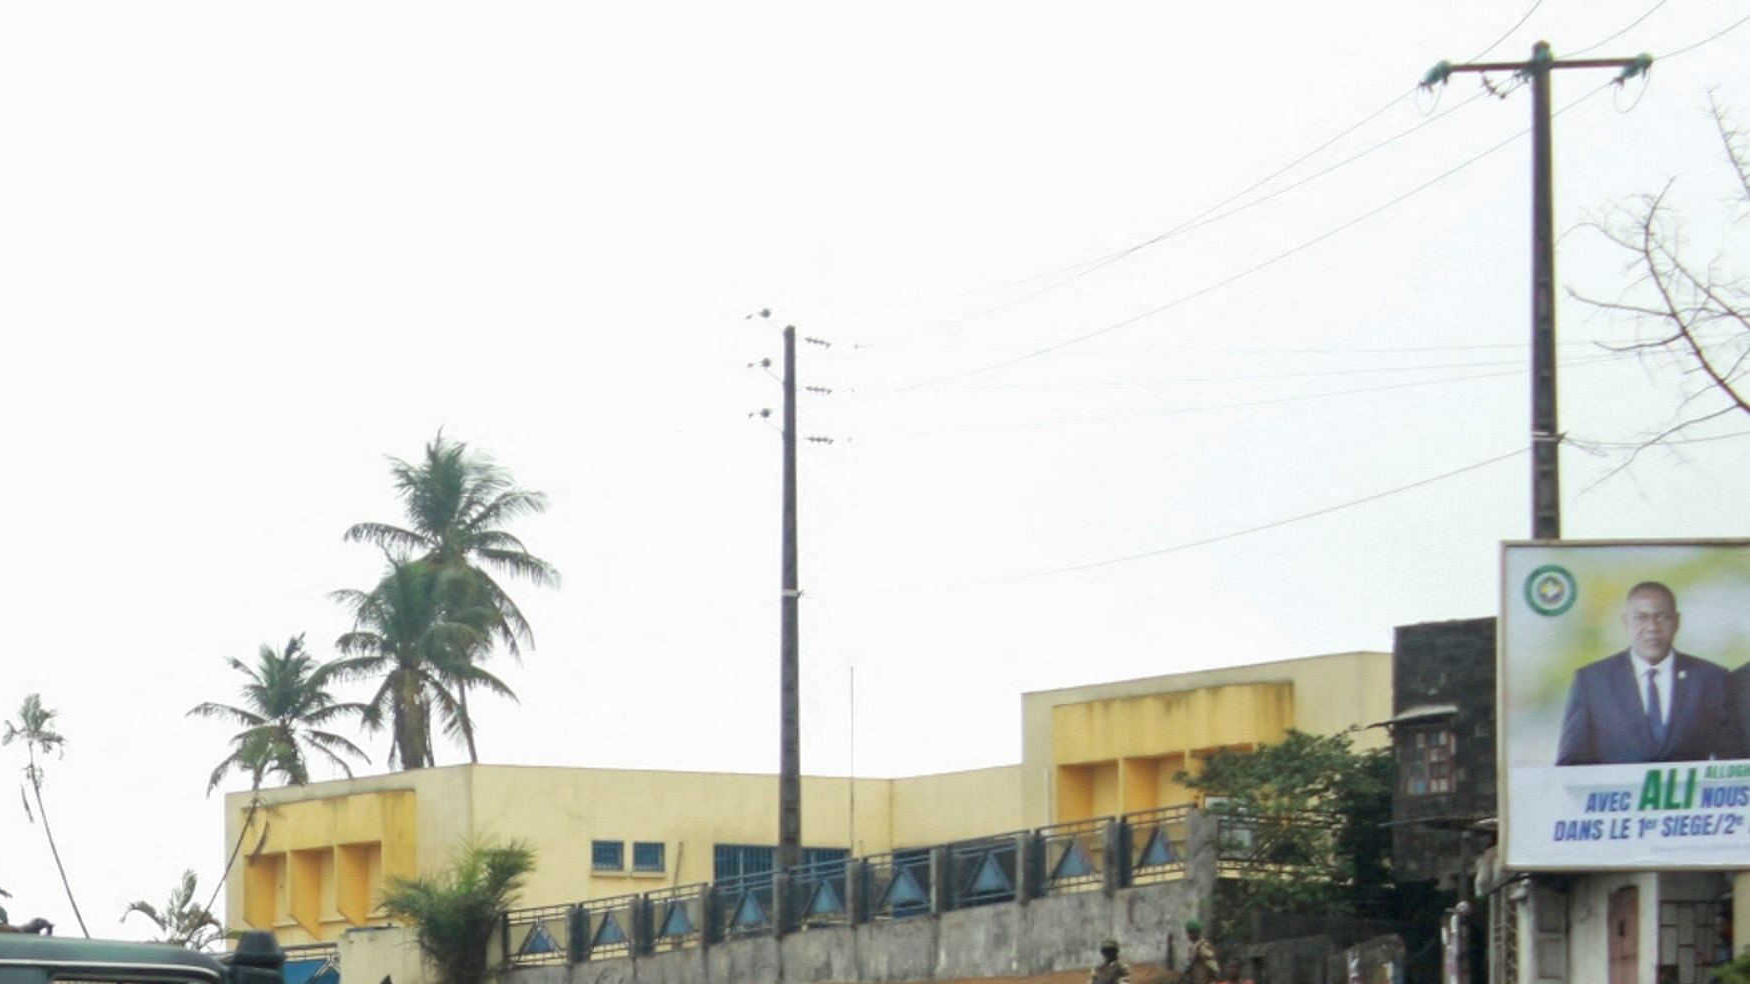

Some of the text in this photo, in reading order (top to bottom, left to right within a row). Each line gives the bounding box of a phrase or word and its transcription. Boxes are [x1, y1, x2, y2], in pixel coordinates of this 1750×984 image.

[1584, 768, 1750, 814] AVEC ALI NOUS
[1553, 819, 1604, 842] DANS
[1609, 818, 1632, 840] LE
[1637, 817, 1659, 839] 1er
